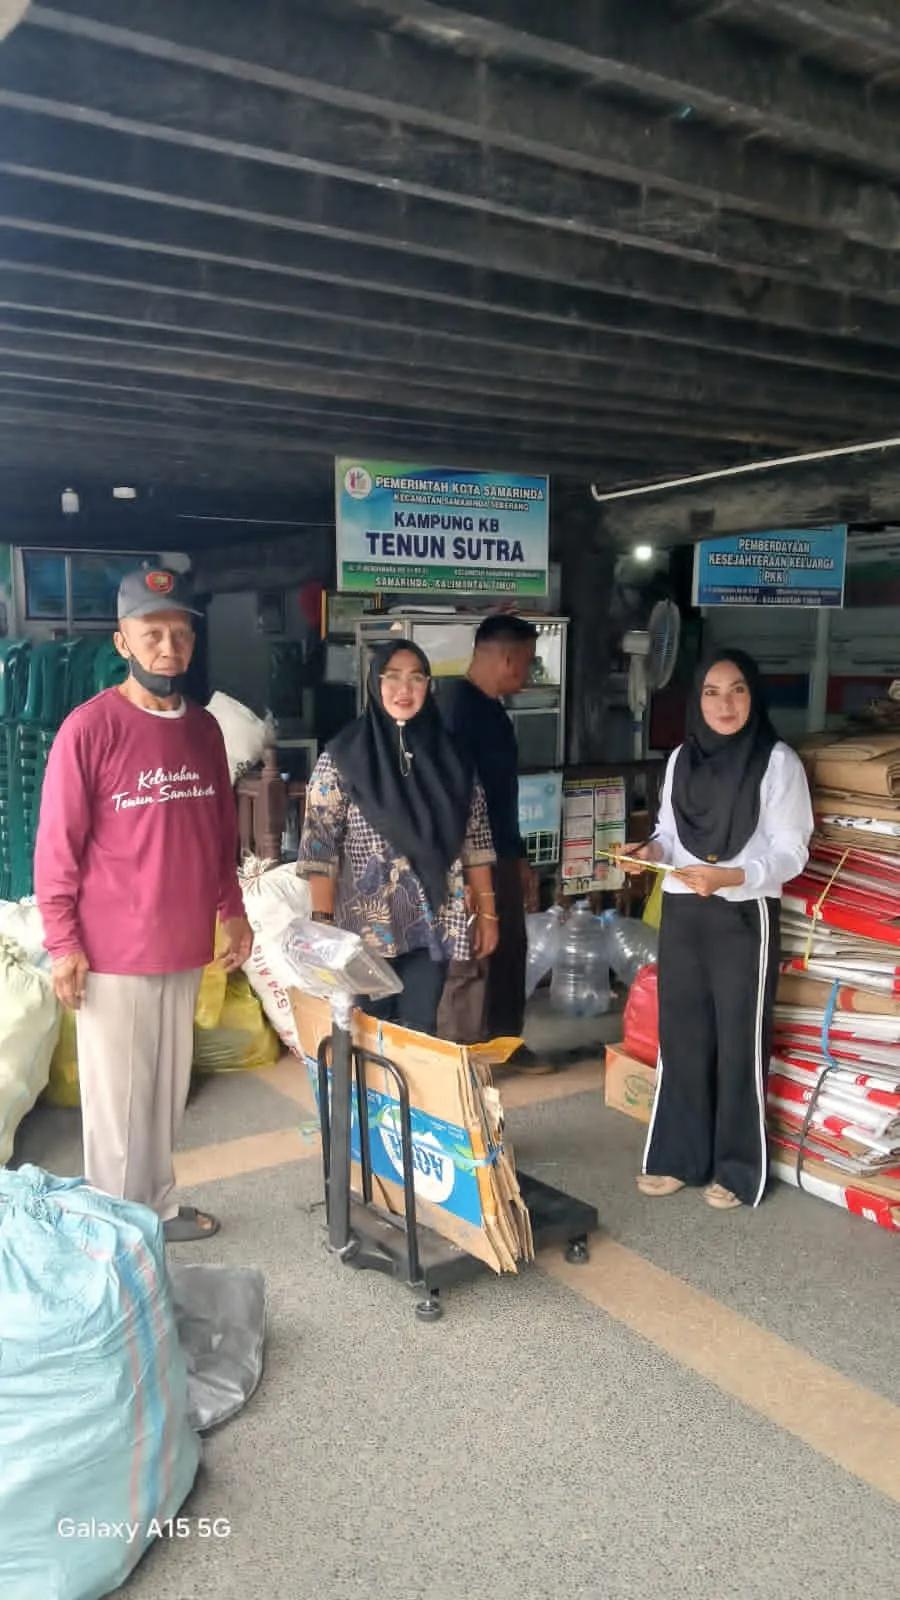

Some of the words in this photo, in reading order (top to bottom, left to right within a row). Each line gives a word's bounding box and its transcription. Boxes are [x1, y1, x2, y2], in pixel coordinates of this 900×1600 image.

[375, 476, 448, 493] PEMERINTAH
[452, 483, 480, 496] KOTA
[483, 485, 544, 500] SAMARINDA
[394, 494, 442, 505] KECAMATAN
[491, 501, 529, 512] SEBERANG
[394, 511, 473, 531] KAMPUNG
[479, 517, 499, 533] KB
[365, 532, 445, 559] TENUN
[452, 537, 524, 562] SUTRA
[738, 538, 810, 554] PEMBERDAYAAN
[708, 553, 787, 568] KESEJAHTERAAN
[789, 556, 834, 570] KELUARGA
[375, 577, 427, 589] SAMARINDA
[435, 578, 488, 592] KALIMANTAN
[489, 580, 517, 593] TIMUR
[137, 765, 200, 792] Kelurahan
[111, 791, 153, 813] Tenun
[387, 1133, 444, 1184] AQA
